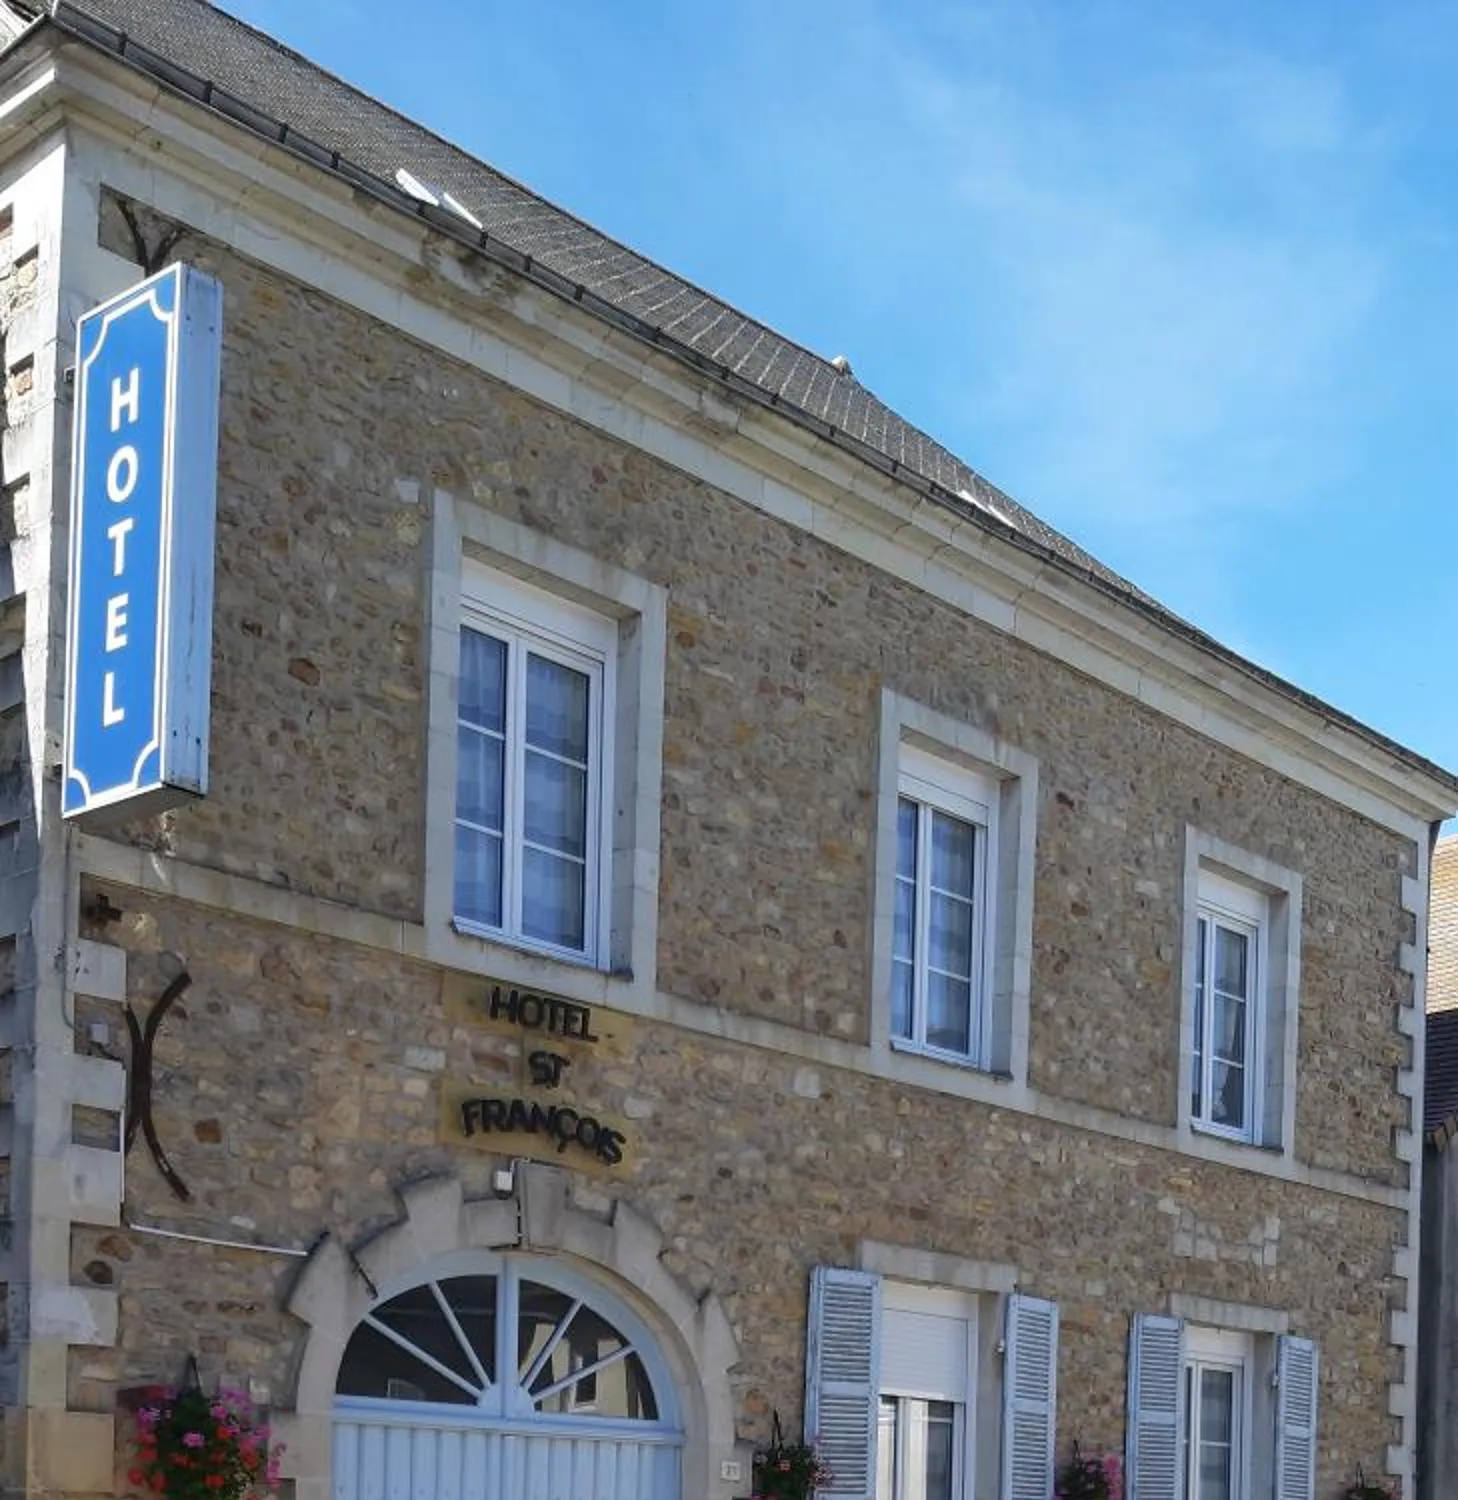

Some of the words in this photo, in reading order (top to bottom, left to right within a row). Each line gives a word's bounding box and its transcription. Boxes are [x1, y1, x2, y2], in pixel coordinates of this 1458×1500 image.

[103, 367, 139, 727] HOTEL
[490, 986, 598, 1042] HOTEL
[528, 1051, 571, 1089] ST
[462, 1099, 626, 1166] FRANÇOIS
